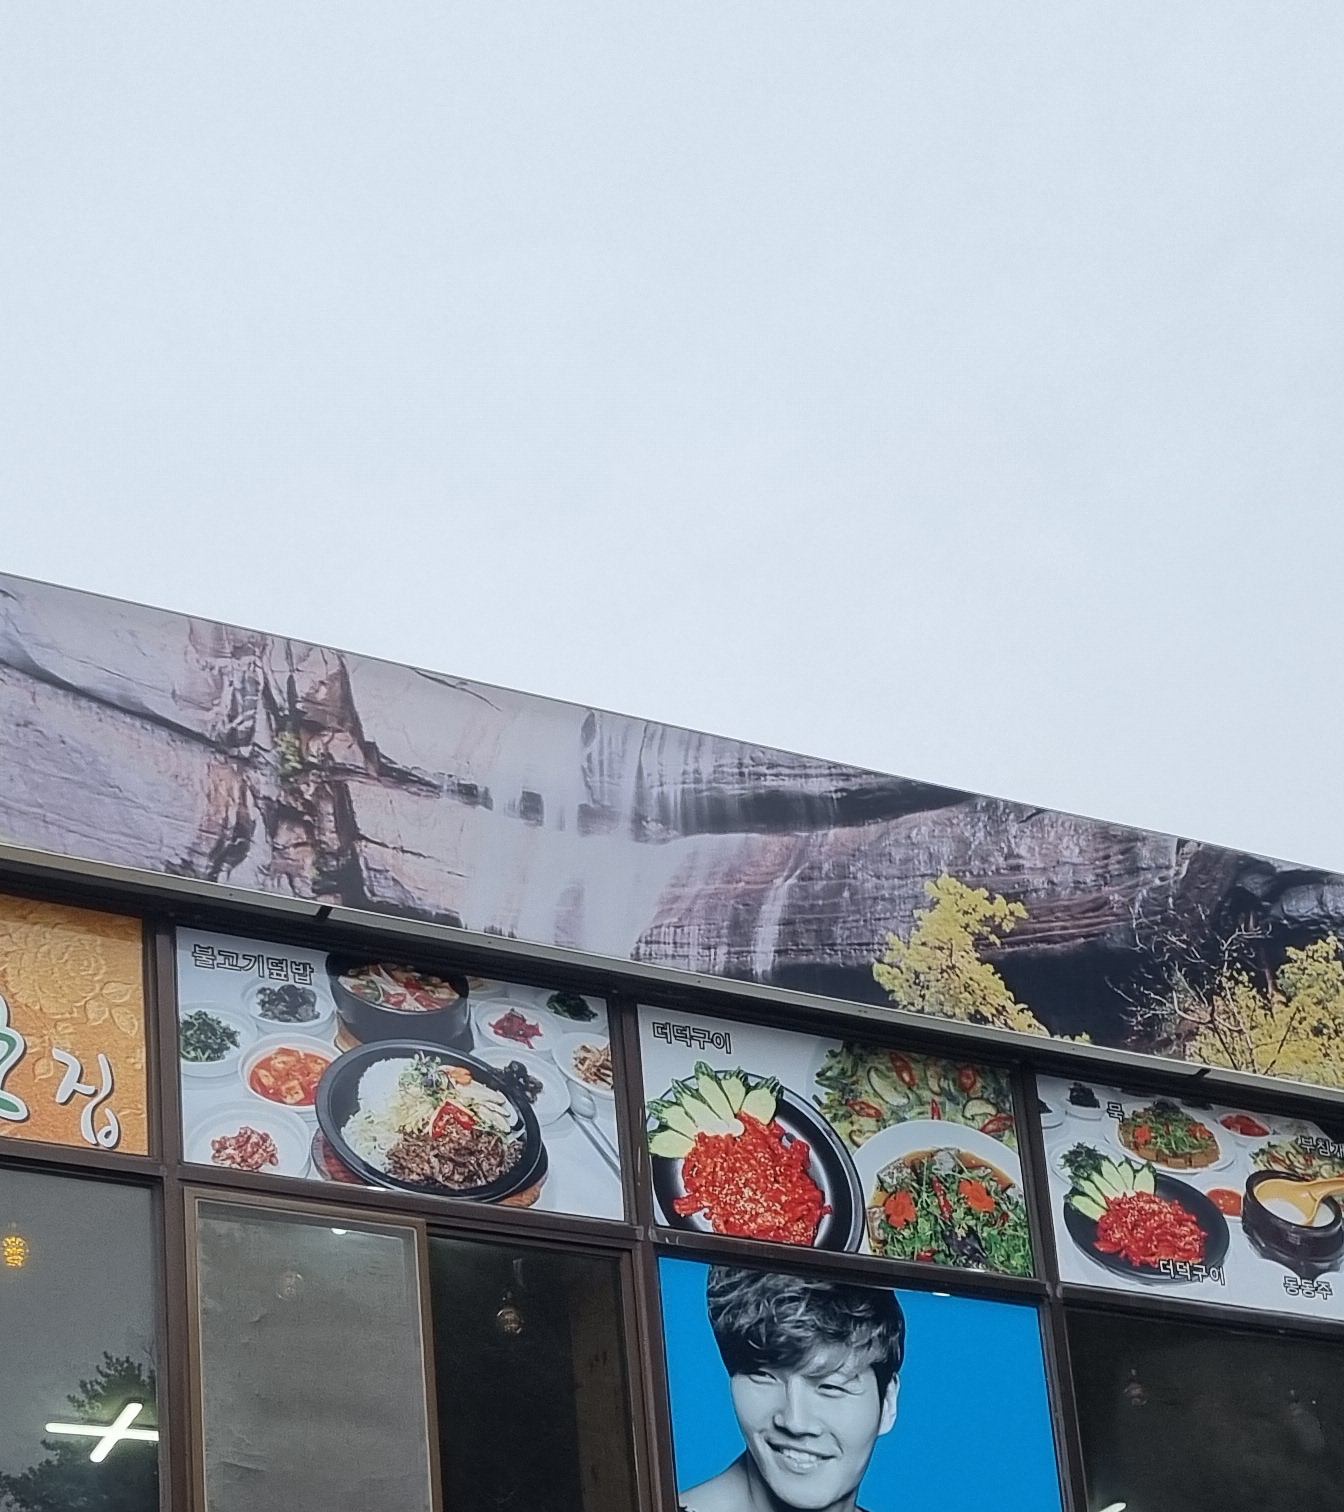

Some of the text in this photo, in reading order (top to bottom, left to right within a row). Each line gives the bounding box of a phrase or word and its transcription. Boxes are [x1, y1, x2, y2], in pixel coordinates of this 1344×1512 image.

[191, 943, 315, 985] 불고기덮밥
[652, 1021, 732, 1054] 더덕구이
[1106, 1101, 1124, 1122] 묵
[1158, 1258, 1226, 1286] 더덕구이
[1282, 1275, 1335, 1300] 동동주
